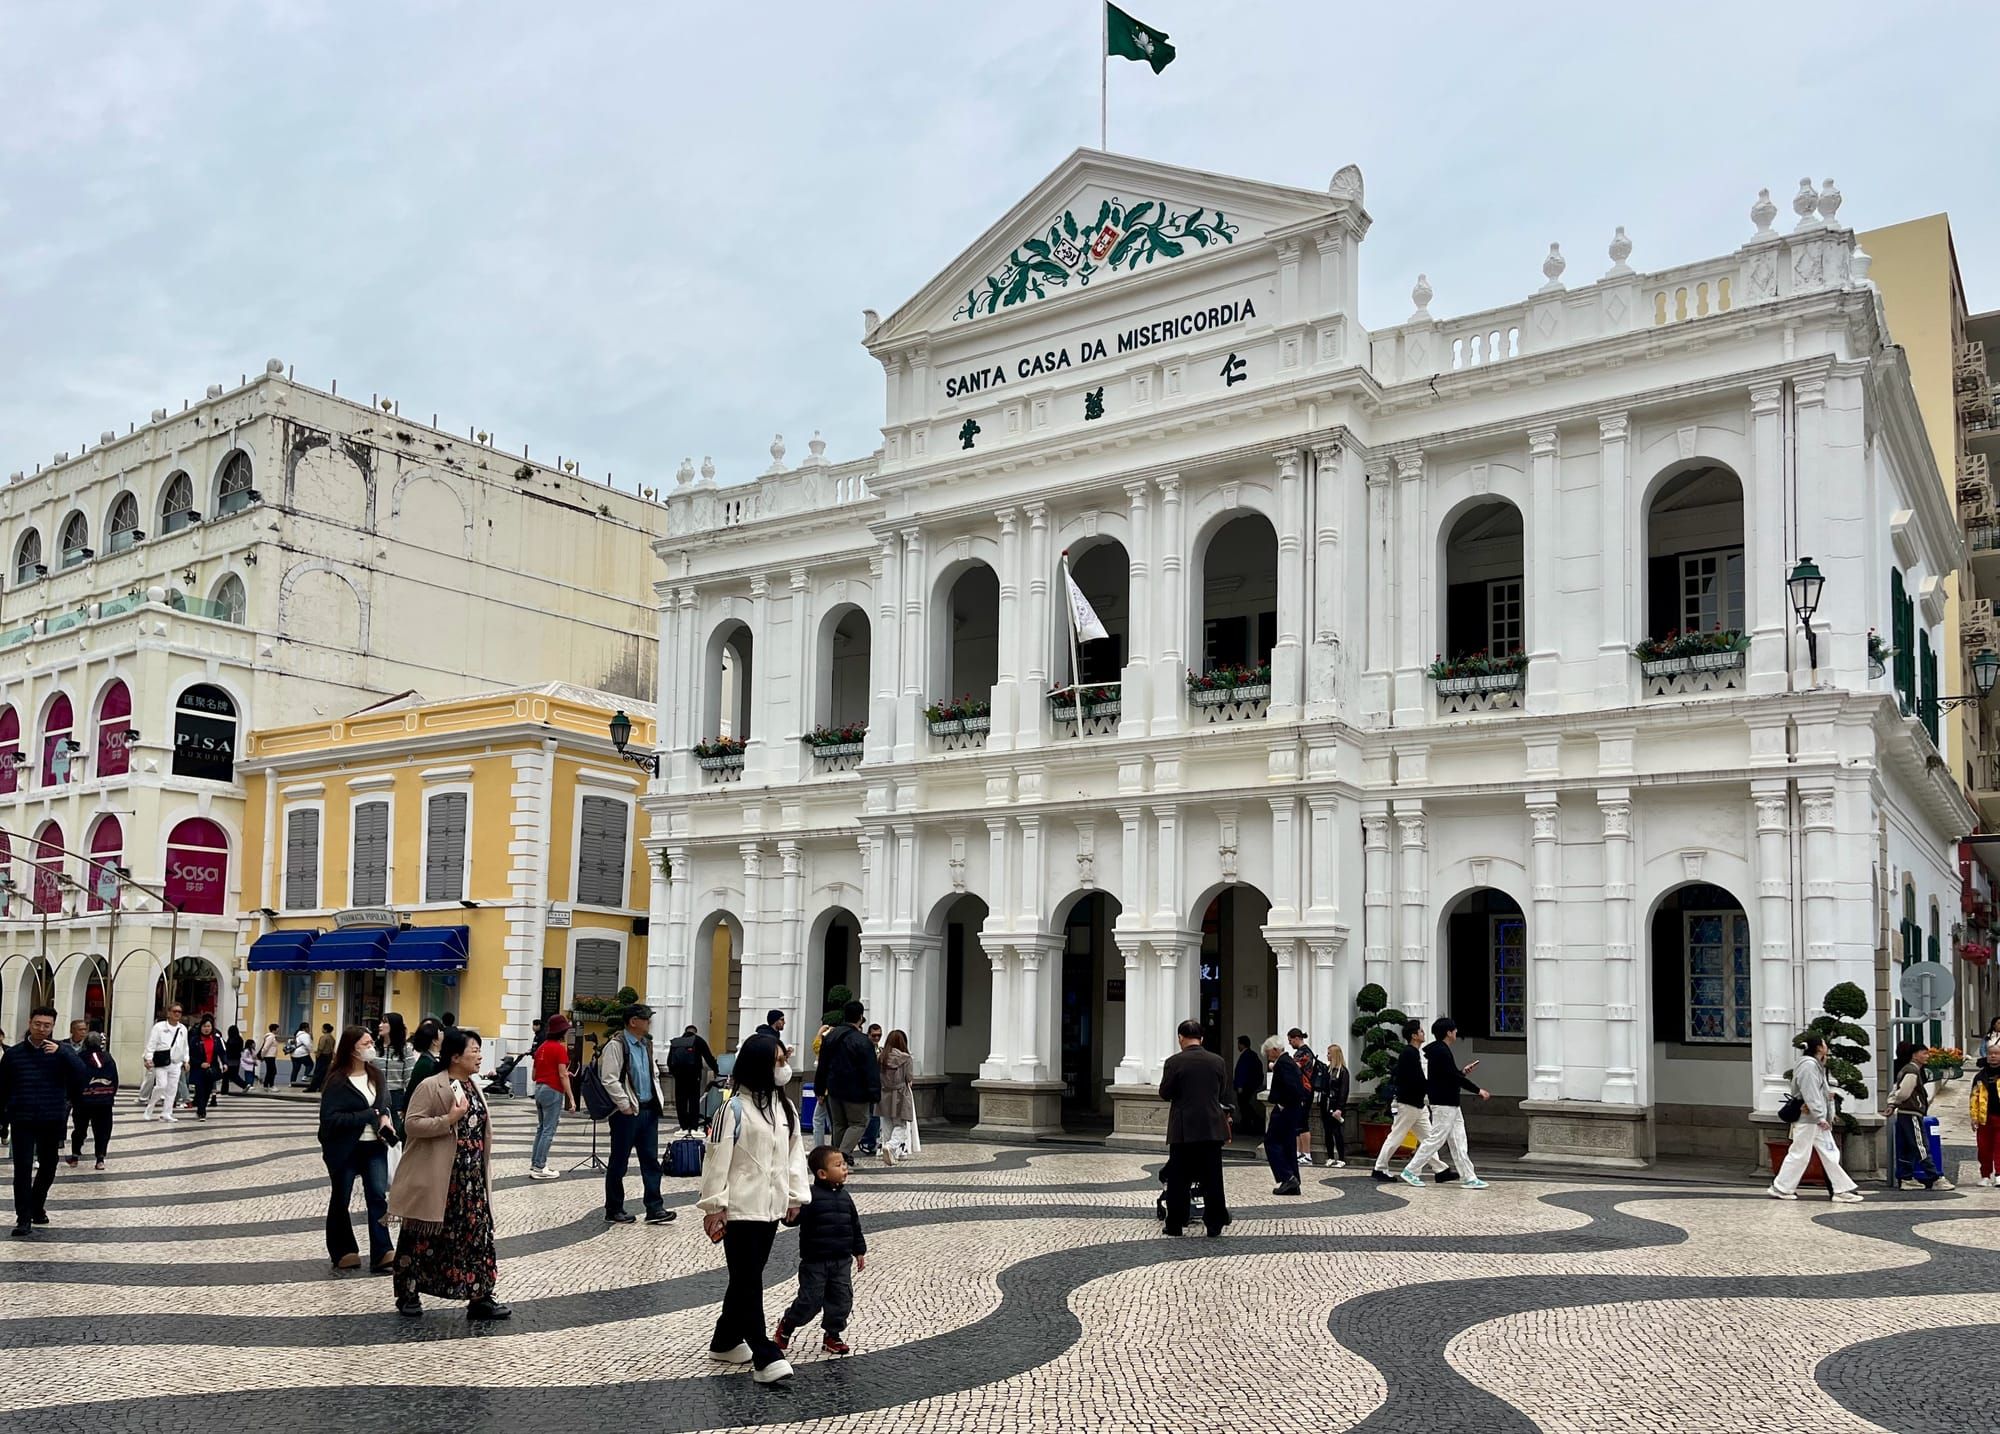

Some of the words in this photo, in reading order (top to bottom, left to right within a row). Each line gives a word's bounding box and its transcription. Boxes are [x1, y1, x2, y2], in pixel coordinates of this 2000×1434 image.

[946, 366, 1006, 398] SANTA
[1018, 348, 1071, 378] CASA
[1081, 338, 1107, 363] DA
[1117, 298, 1256, 354] MISERICORDIA
[183, 694, 228, 711] 匯聚名牌
[176, 733, 231, 753] PISA
[172, 862, 219, 882] Sasa
